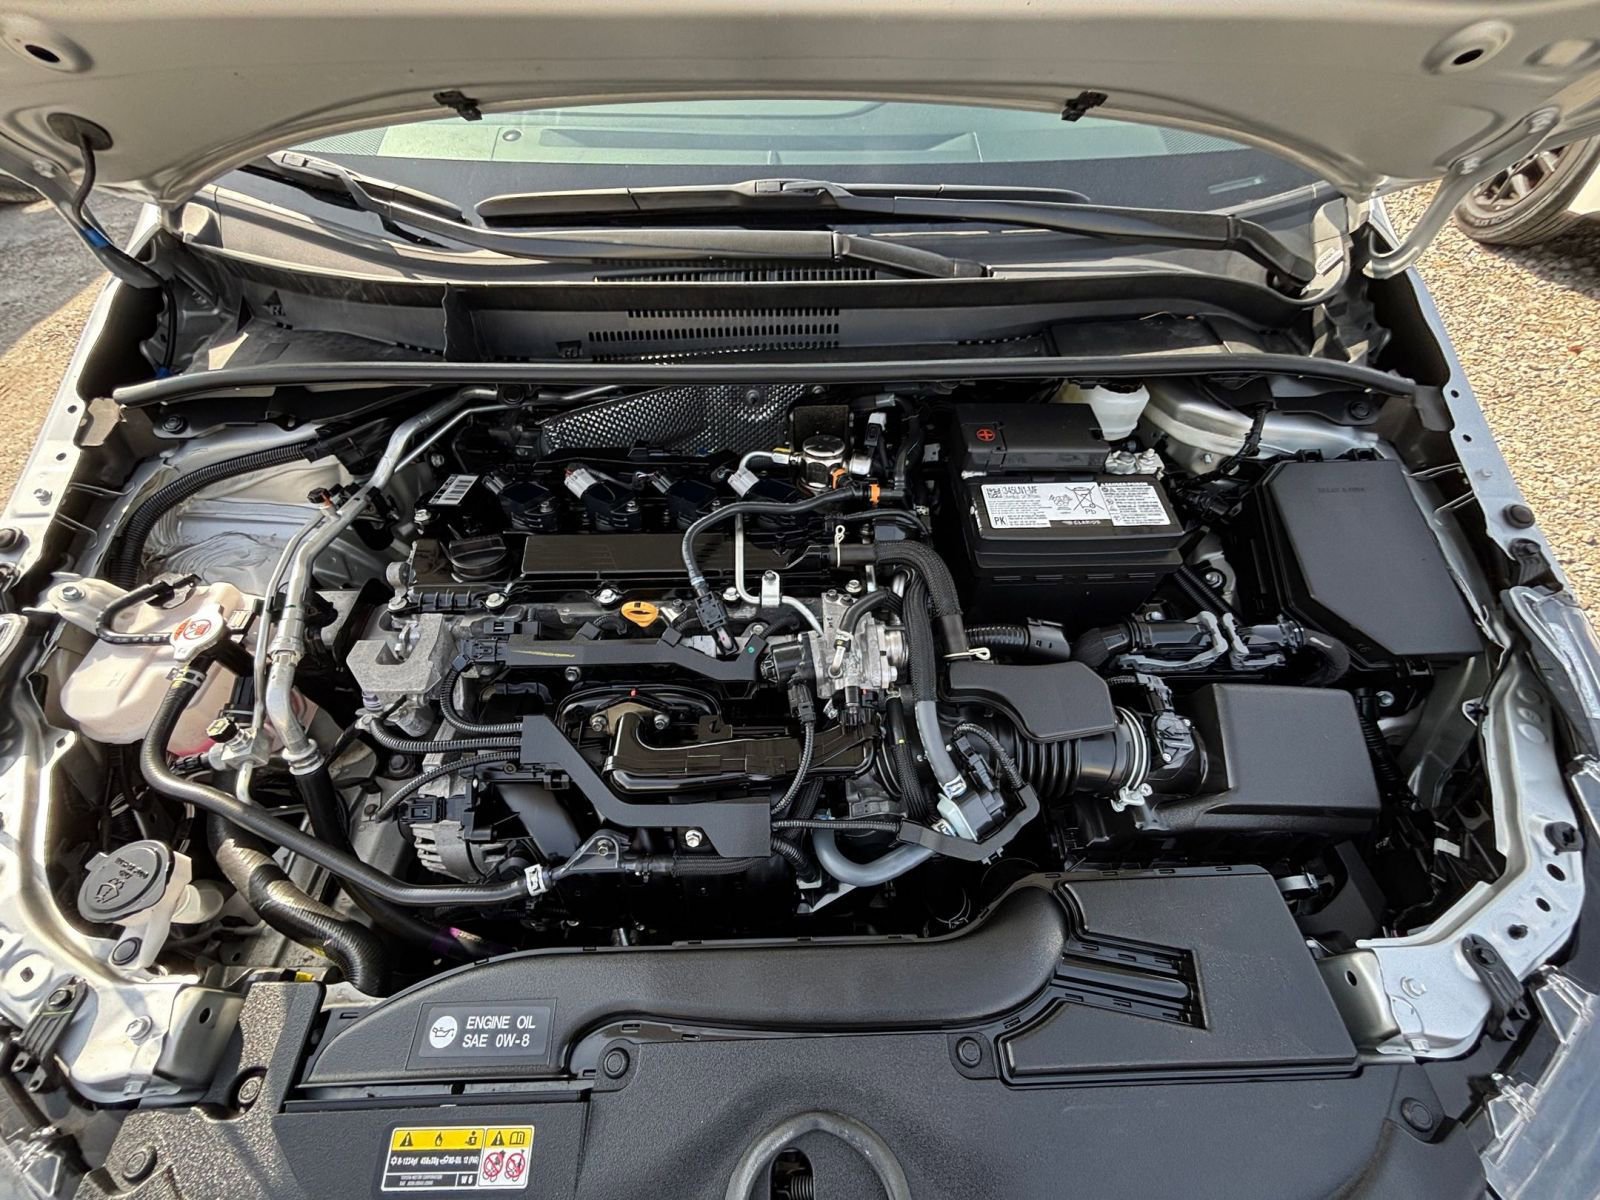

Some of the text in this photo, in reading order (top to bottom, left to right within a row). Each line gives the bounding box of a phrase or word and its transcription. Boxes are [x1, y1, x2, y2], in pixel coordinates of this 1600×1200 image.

[994, 516, 1006, 526] PK
[466, 1015, 536, 1030] ENGINE OIL
[462, 1033, 530, 1048] SAE 0W-8
